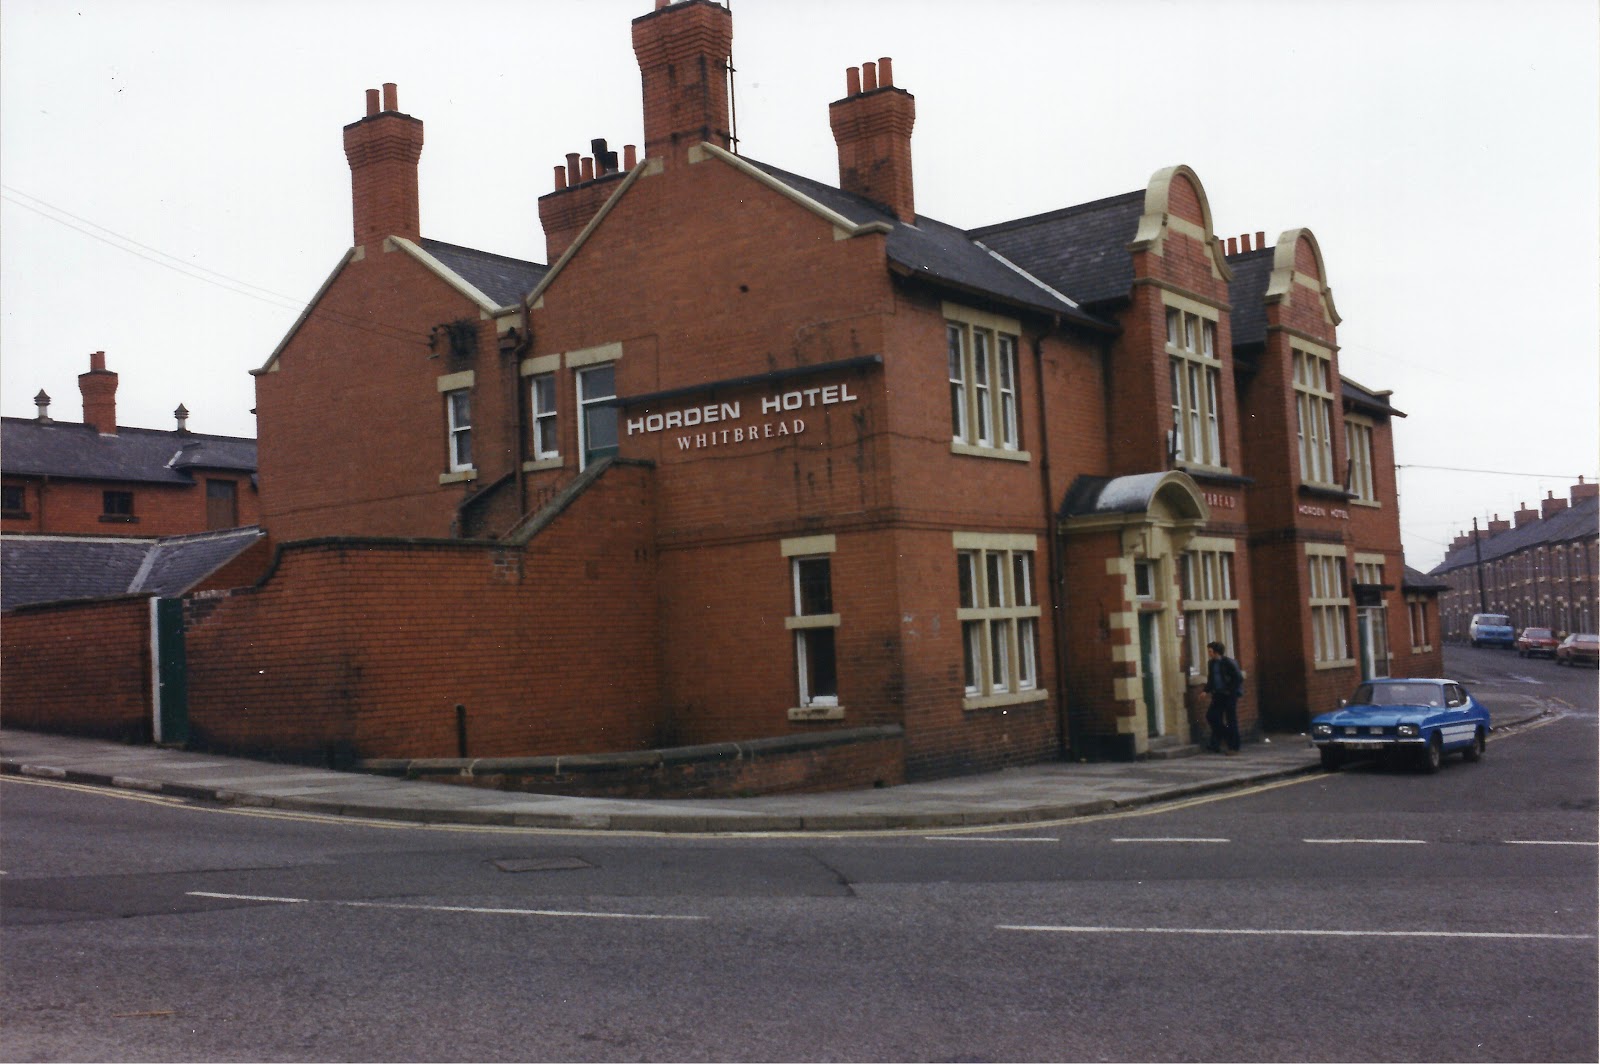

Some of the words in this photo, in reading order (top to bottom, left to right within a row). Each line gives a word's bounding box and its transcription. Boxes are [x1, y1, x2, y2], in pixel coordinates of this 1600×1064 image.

[627, 401, 740, 436] HORDEN
[761, 383, 858, 415] HOTEL
[677, 419, 805, 450] WHITBREAD
[1298, 504, 1326, 517] HORDEN
[1330, 508, 1349, 520] HOTEL
